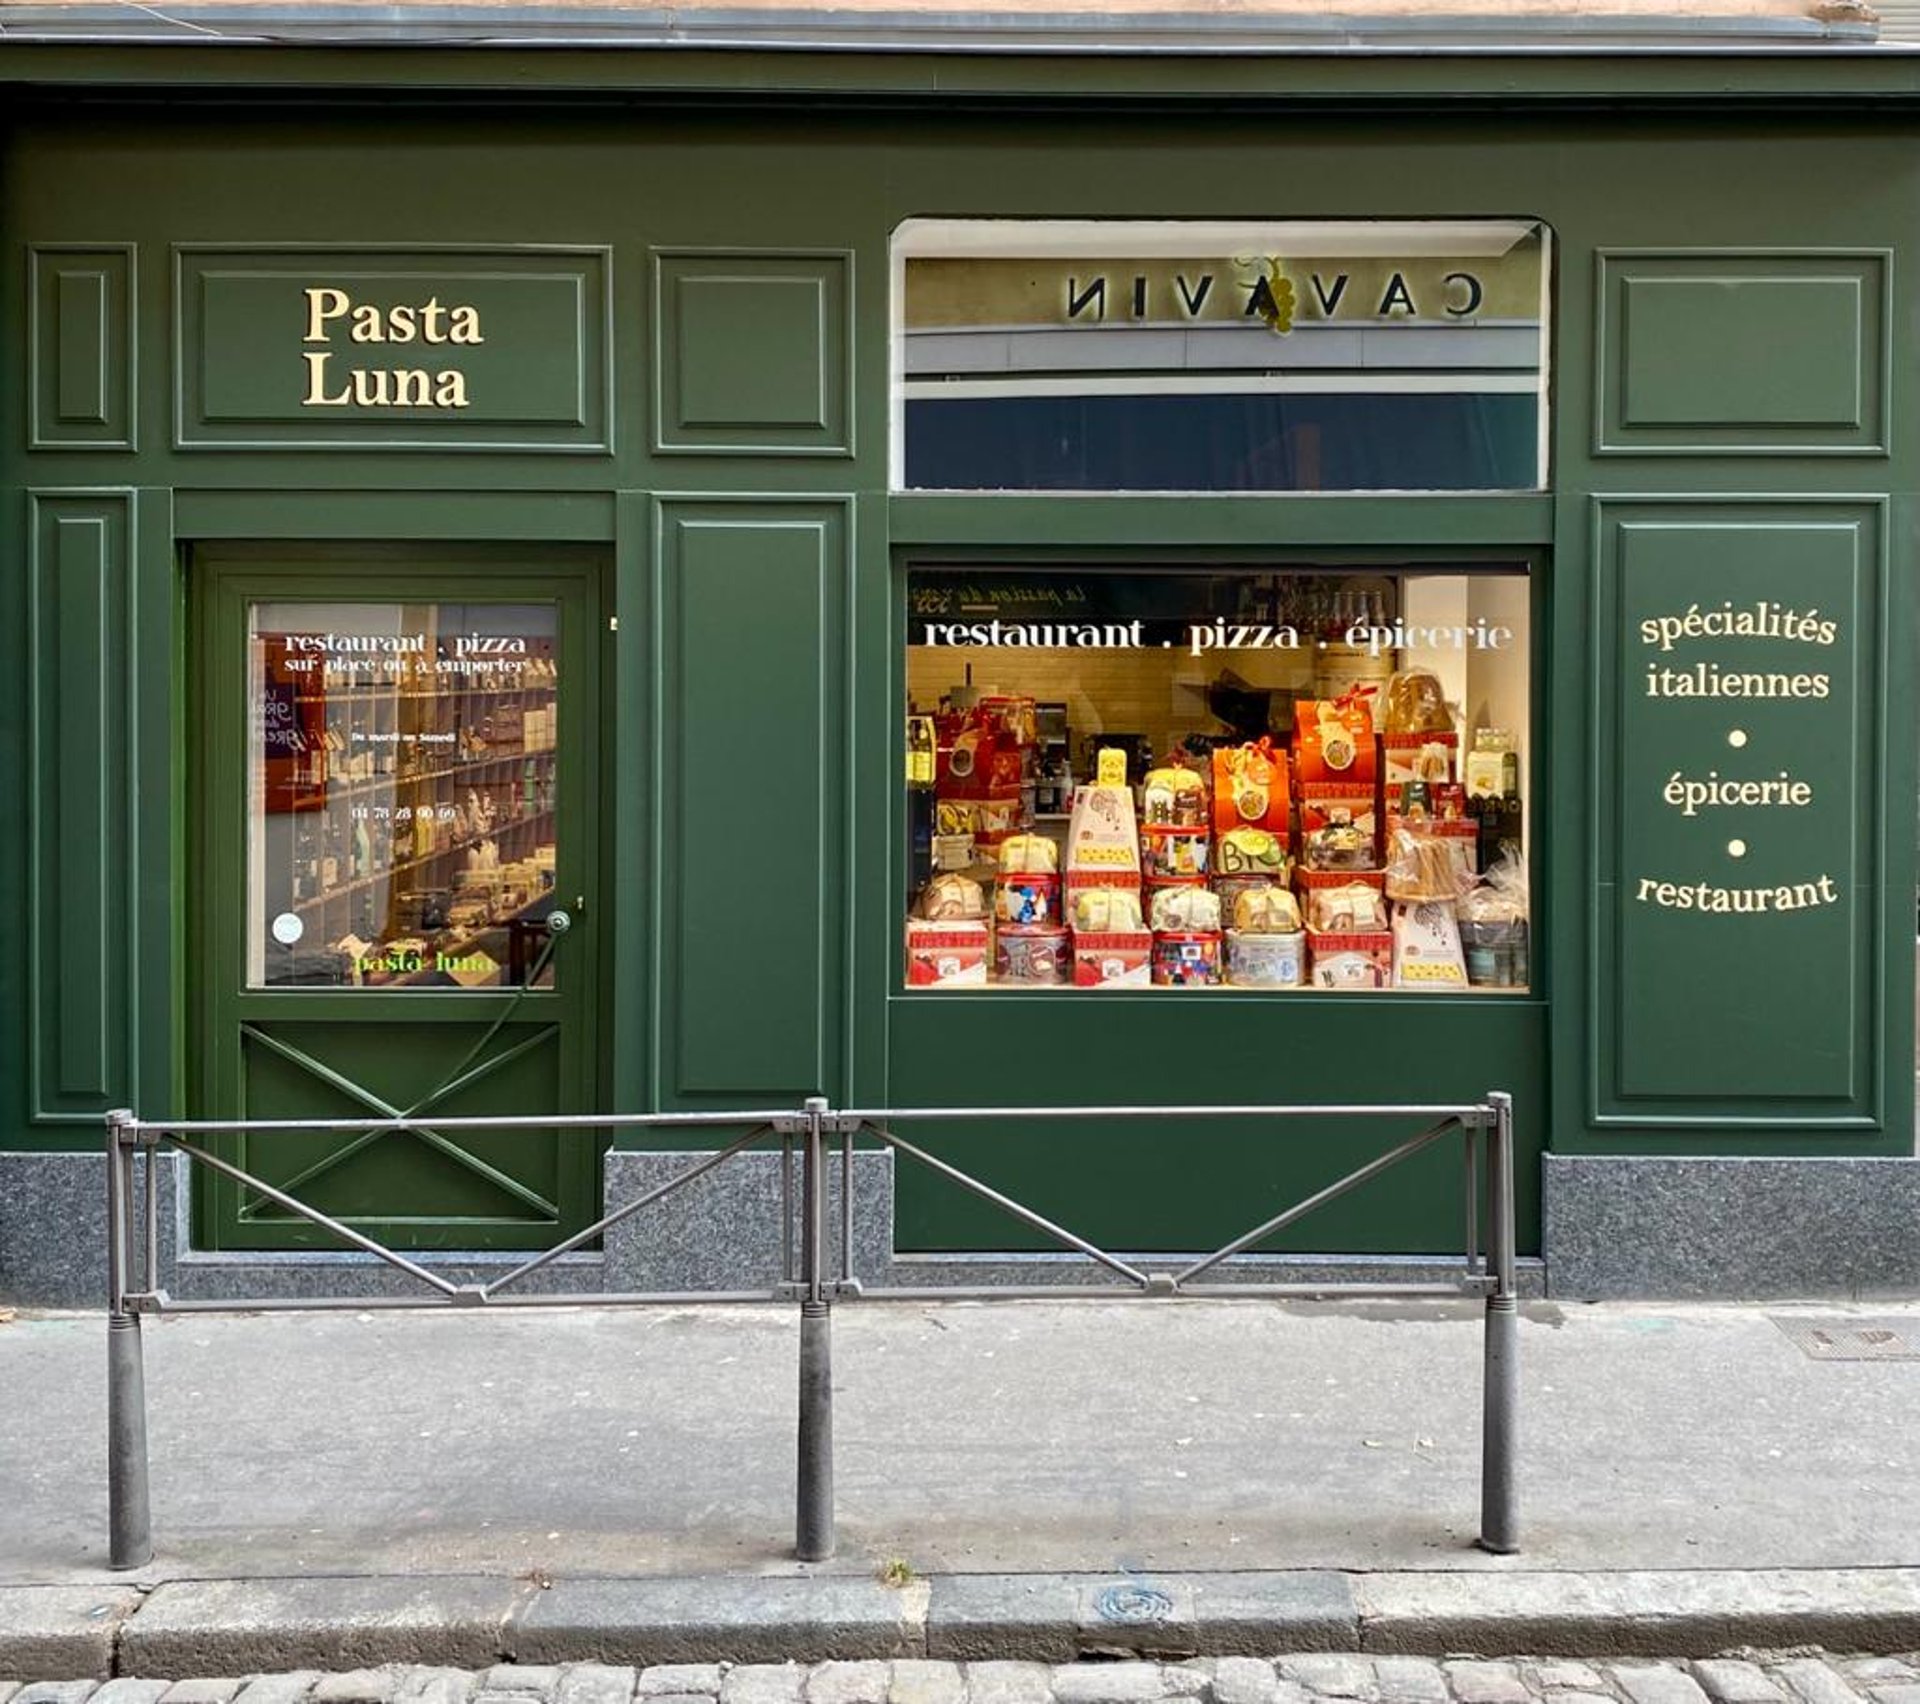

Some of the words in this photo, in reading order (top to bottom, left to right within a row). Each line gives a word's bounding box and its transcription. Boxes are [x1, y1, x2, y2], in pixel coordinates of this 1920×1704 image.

[302, 288, 485, 344] Pasta
[302, 352, 470, 408] Luna
[284, 633, 426, 652] restaurant
[455, 632, 527, 654] pizza
[924, 619, 1145, 648] restaurant
[1189, 616, 1300, 656] pizza
[1345, 616, 1513, 655] épicerie
[1641, 602, 1837, 651] spécialités
[284, 659, 318, 672] sur
[325, 656, 376, 673] place
[435, 657, 527, 676] emporter
[1646, 663, 1831, 697] italiennes
[1664, 771, 1811, 815] épicerie
[1637, 874, 1838, 912] restaurant
[354, 953, 423, 974] pasta
[436, 952, 494, 972] luna
